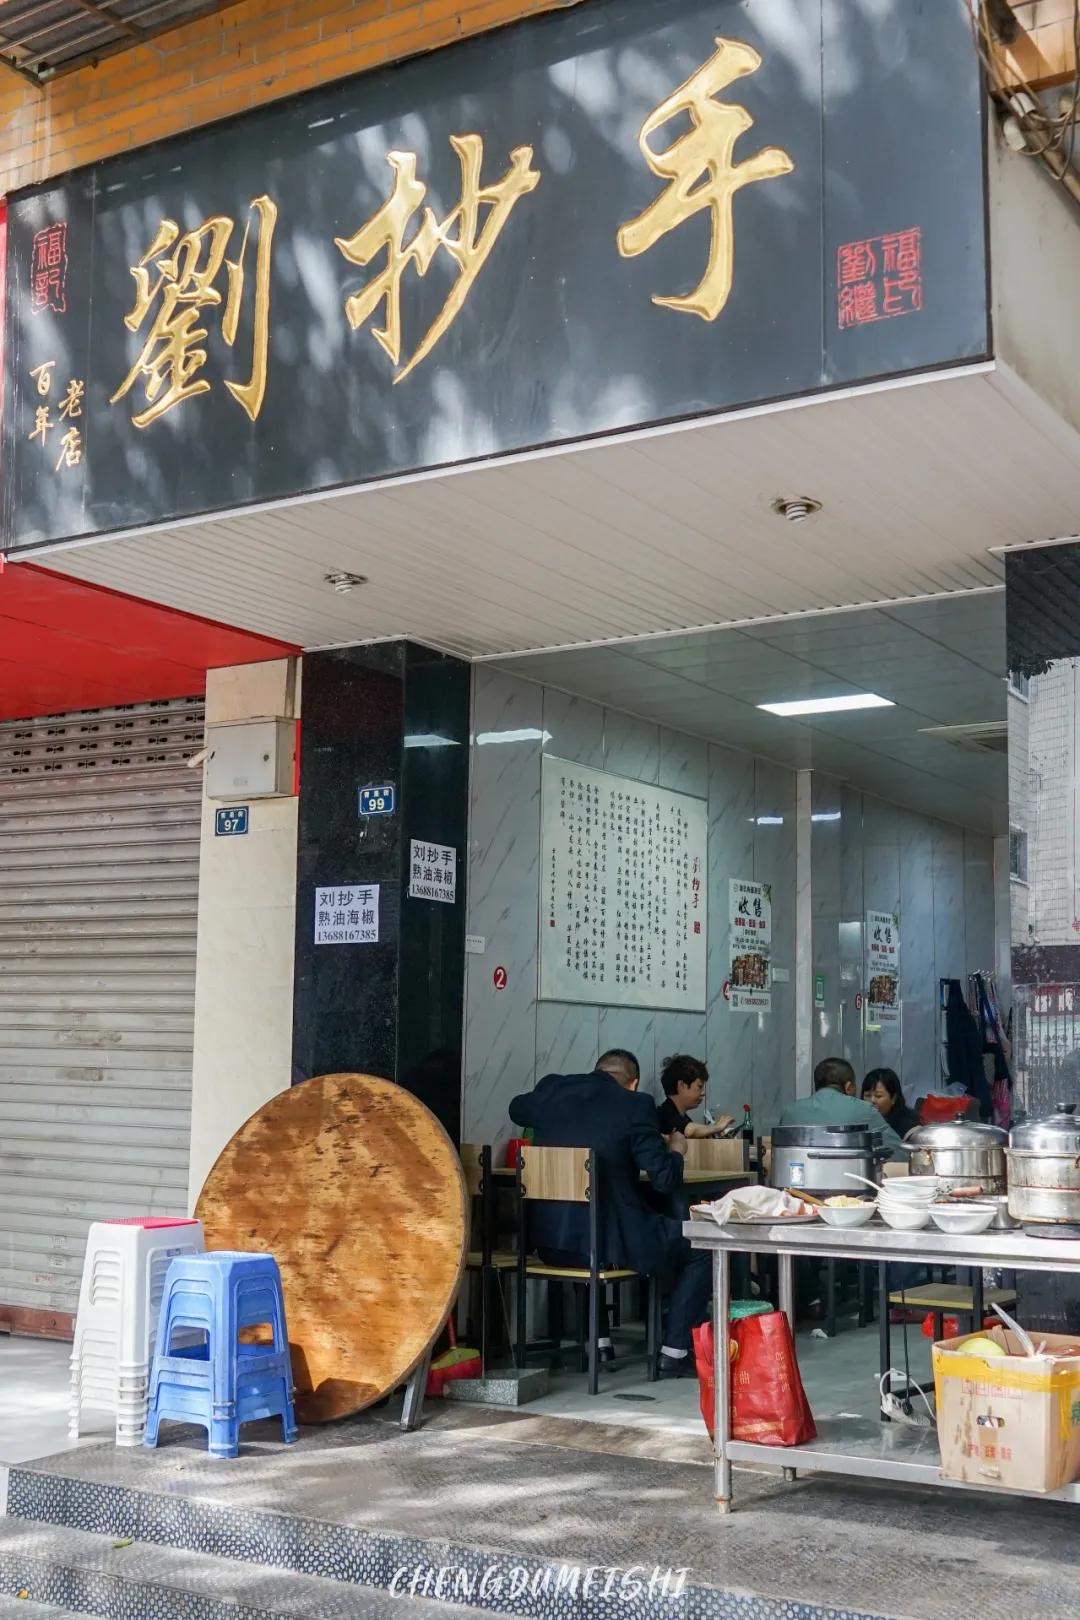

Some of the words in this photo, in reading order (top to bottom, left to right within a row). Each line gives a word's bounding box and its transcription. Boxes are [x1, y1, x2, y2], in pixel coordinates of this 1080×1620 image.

[28, 361, 56, 447] 百年
[55, 380, 86, 472] 老店
[368, 798, 385, 811] 99
[224, 819, 239, 831] 97
[413, 844, 453, 866] 刘抄手
[319, 889, 374, 907] 刘抄手
[318, 908, 375, 927] 熟油海椒
[317, 929, 377, 942] 13688167385
